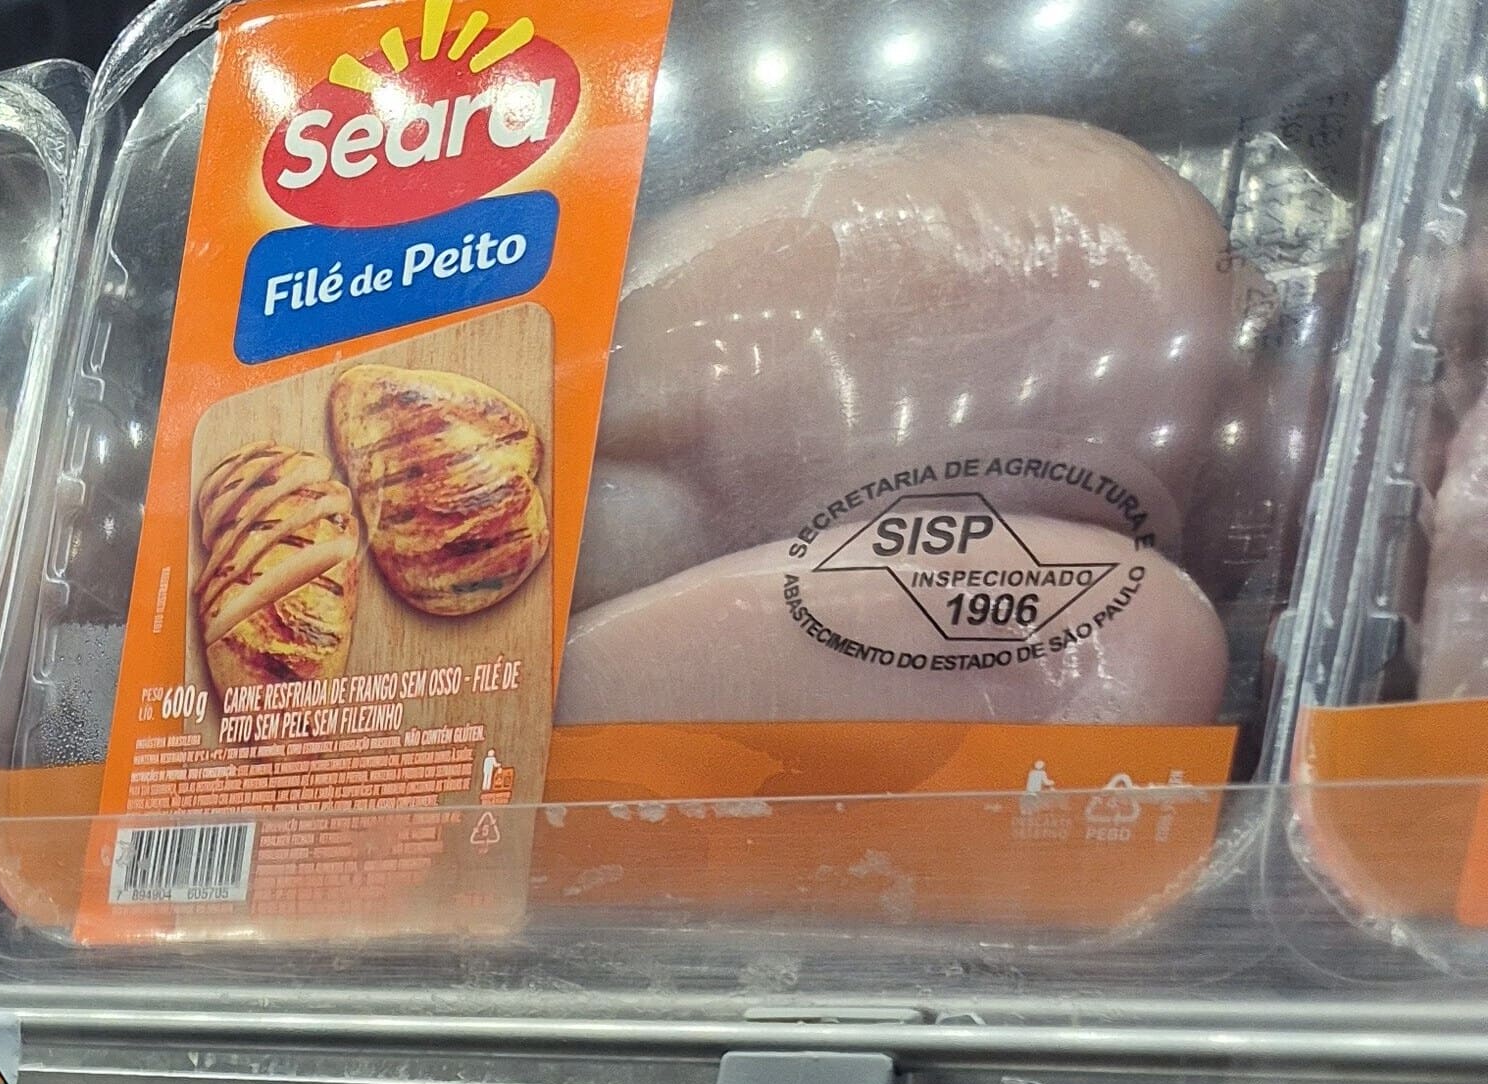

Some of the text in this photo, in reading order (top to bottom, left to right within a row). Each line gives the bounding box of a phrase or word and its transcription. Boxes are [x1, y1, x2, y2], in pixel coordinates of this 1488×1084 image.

[277, 76, 557, 189] Seara
[263, 231, 527, 317] Filé de Peito
[788, 457, 1155, 560] SECRETARIA DE AGRICULTURA E
[872, 515, 995, 557] SISP
[911, 570, 1093, 589] INSPECIONADO
[783, 565, 1147, 672] ABASTECIMENTO DO ESTADO DE SÃO PAULO
[945, 593, 1041, 627] 1906
[141, 687, 164, 702] PESO
[223, 684, 263, 714] CARNE
[264, 676, 329, 710] RESFRIADA
[330, 674, 348, 702] DE
[349, 672, 398, 701] FRANGO
[399, 670, 427, 698] SEM
[428, 668, 462, 695] OSSO
[473, 656, 504, 692] FILÉ
[502, 660, 523, 689] DE
[219, 702, 405, 744] PEITO SEM PELE SEM FILEZINHO
